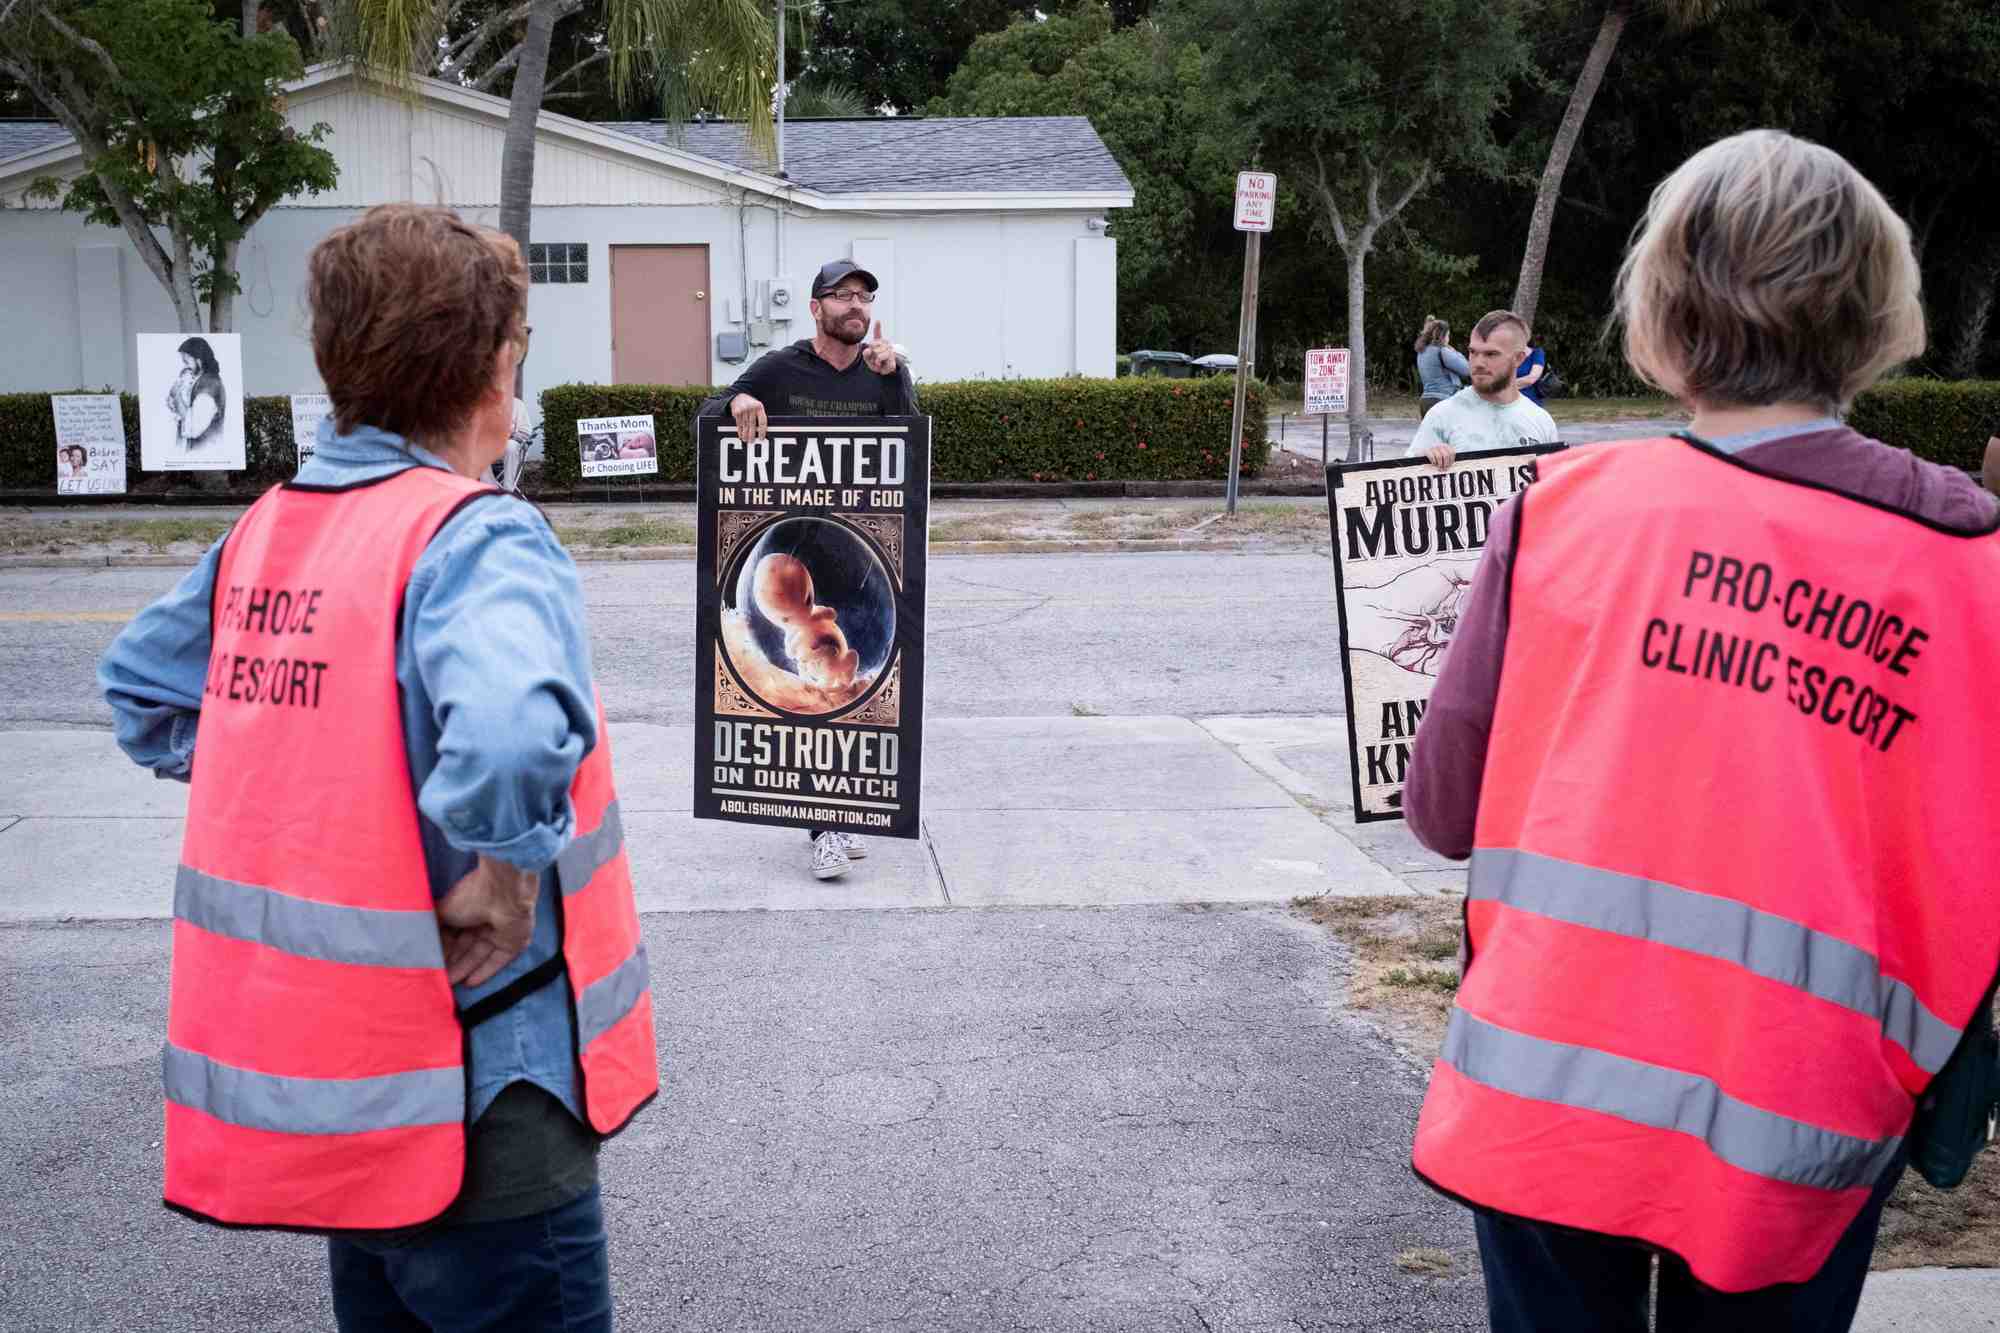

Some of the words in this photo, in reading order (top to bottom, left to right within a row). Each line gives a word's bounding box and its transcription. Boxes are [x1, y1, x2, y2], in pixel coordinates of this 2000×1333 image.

[1240, 191, 1272, 200] PARKING
[1248, 178, 1265, 189] NO
[1245, 209, 1264, 217] TIME
[1247, 200, 1263, 209] ANY
[1310, 353, 1325, 364] TOW
[1327, 352, 1345, 364] AWAY
[1319, 365, 1336, 376] ZONE
[580, 421, 617, 431] Thanks
[620, 418, 652, 429] Mom,
[582, 464, 595, 473] For
[597, 463, 635, 473] Choosing
[636, 459, 656, 470] LIFE!
[718, 437, 905, 485] CREATED
[718, 487, 736, 504] IN
[742, 488, 774, 505] THE
[780, 489, 834, 507] IMAGE
[842, 490, 864, 507] OF
[871, 490, 905, 508] GOD
[1364, 467, 1496, 506] ABORTION
[1509, 465, 1536, 492] IS
[1343, 498, 1508, 560] MURD
[1683, 550, 1929, 677] PRO-CHOICE
[1641, 618, 1779, 692] CLINIC
[1786, 655, 1917, 752] ESCORT
[1380, 699, 1427, 739] AN
[713, 720, 899, 776] DESTROYED
[1365, 743, 1410, 785] KN
[713, 766, 744, 785] ON
[754, 769, 800, 790] OUR
[811, 774, 898, 799] WATCH
[720, 799, 891, 828] ABOLISHHUMANABORTION.COM
